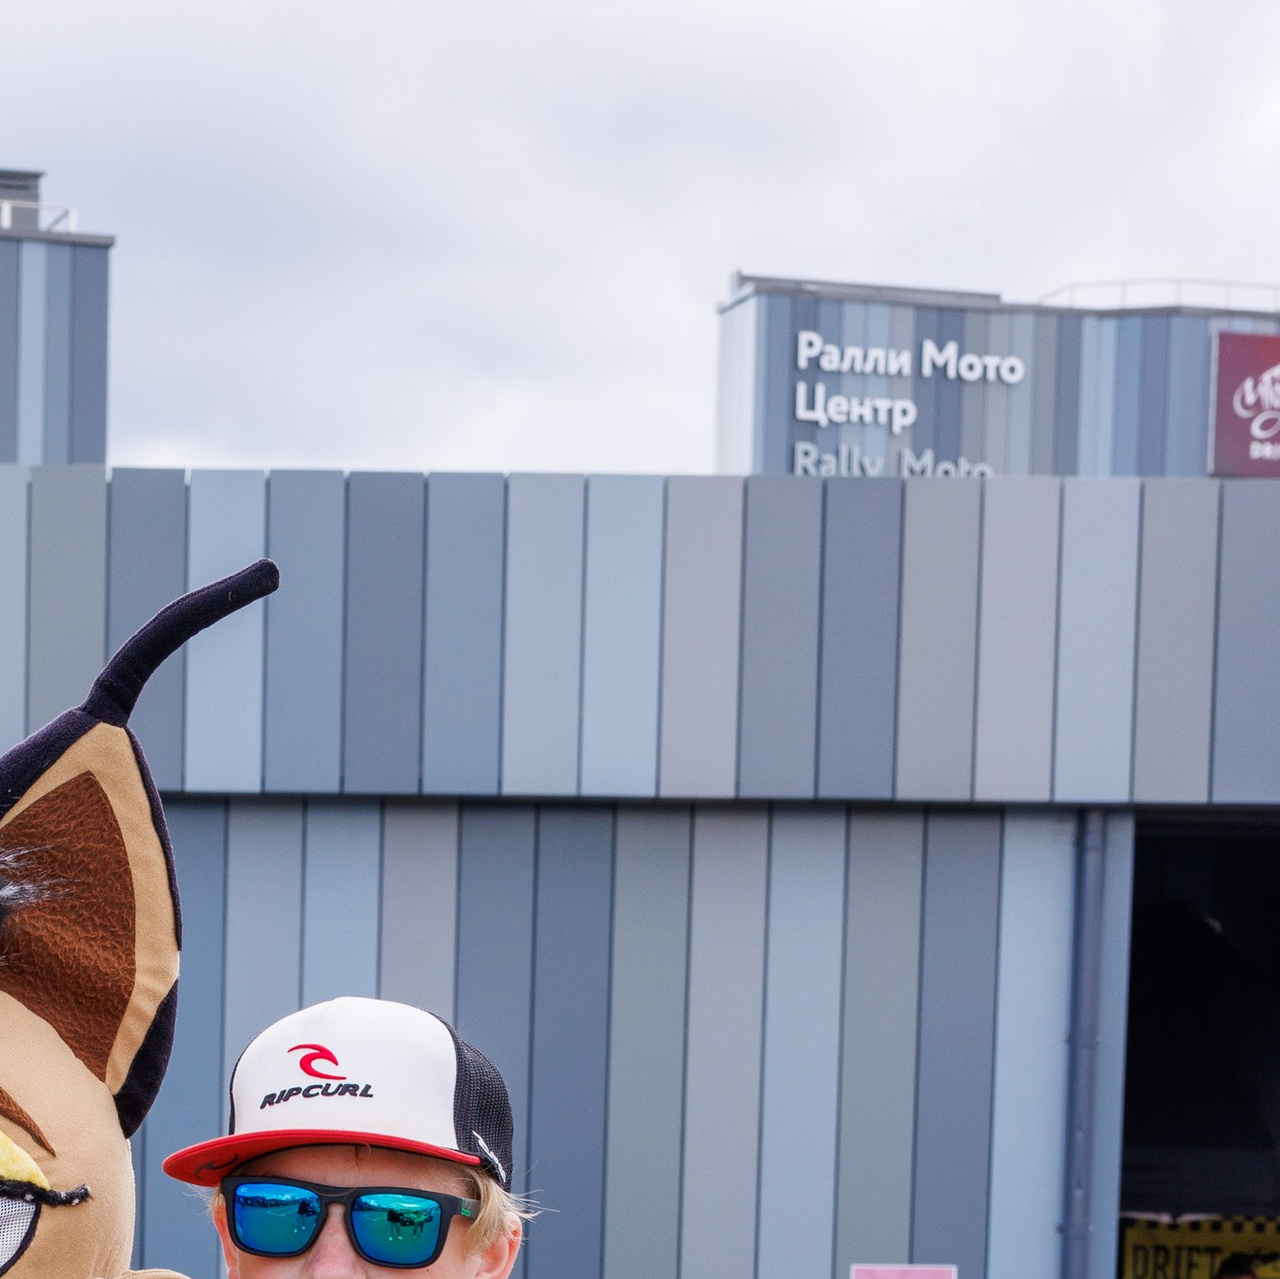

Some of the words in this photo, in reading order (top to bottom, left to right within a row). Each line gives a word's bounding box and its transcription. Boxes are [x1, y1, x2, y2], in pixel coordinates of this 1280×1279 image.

[797, 330, 912, 377] Ралли
[921, 338, 1025, 384] Мото
[795, 380, 917, 435] Центр
[902, 447, 994, 478] Moto
